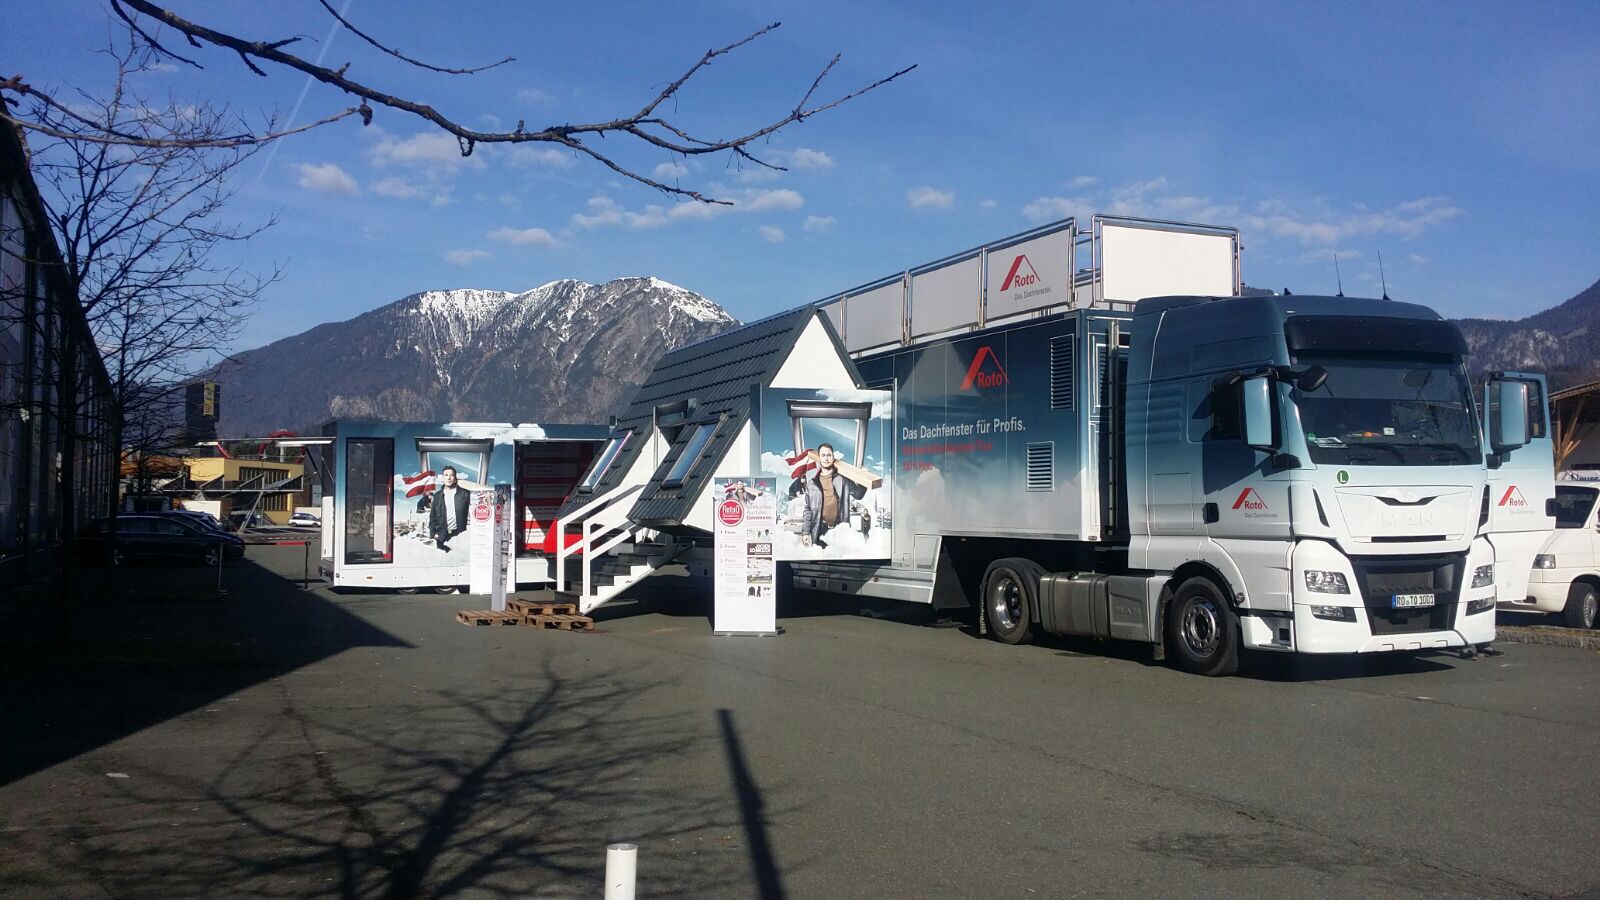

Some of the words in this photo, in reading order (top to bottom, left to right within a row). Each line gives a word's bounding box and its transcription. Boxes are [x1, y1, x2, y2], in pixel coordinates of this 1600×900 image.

[1014, 274, 1035, 288] Roto
[977, 371, 1003, 388] Roto
[902, 427, 918, 440] Das
[920, 423, 974, 438] Dachfenster
[976, 419, 991, 434] für
[993, 416, 1026, 433] Profis.
[1339, 472, 1347, 483] L
[1244, 500, 1263, 510] Roto
[1509, 498, 1525, 506] Roto
